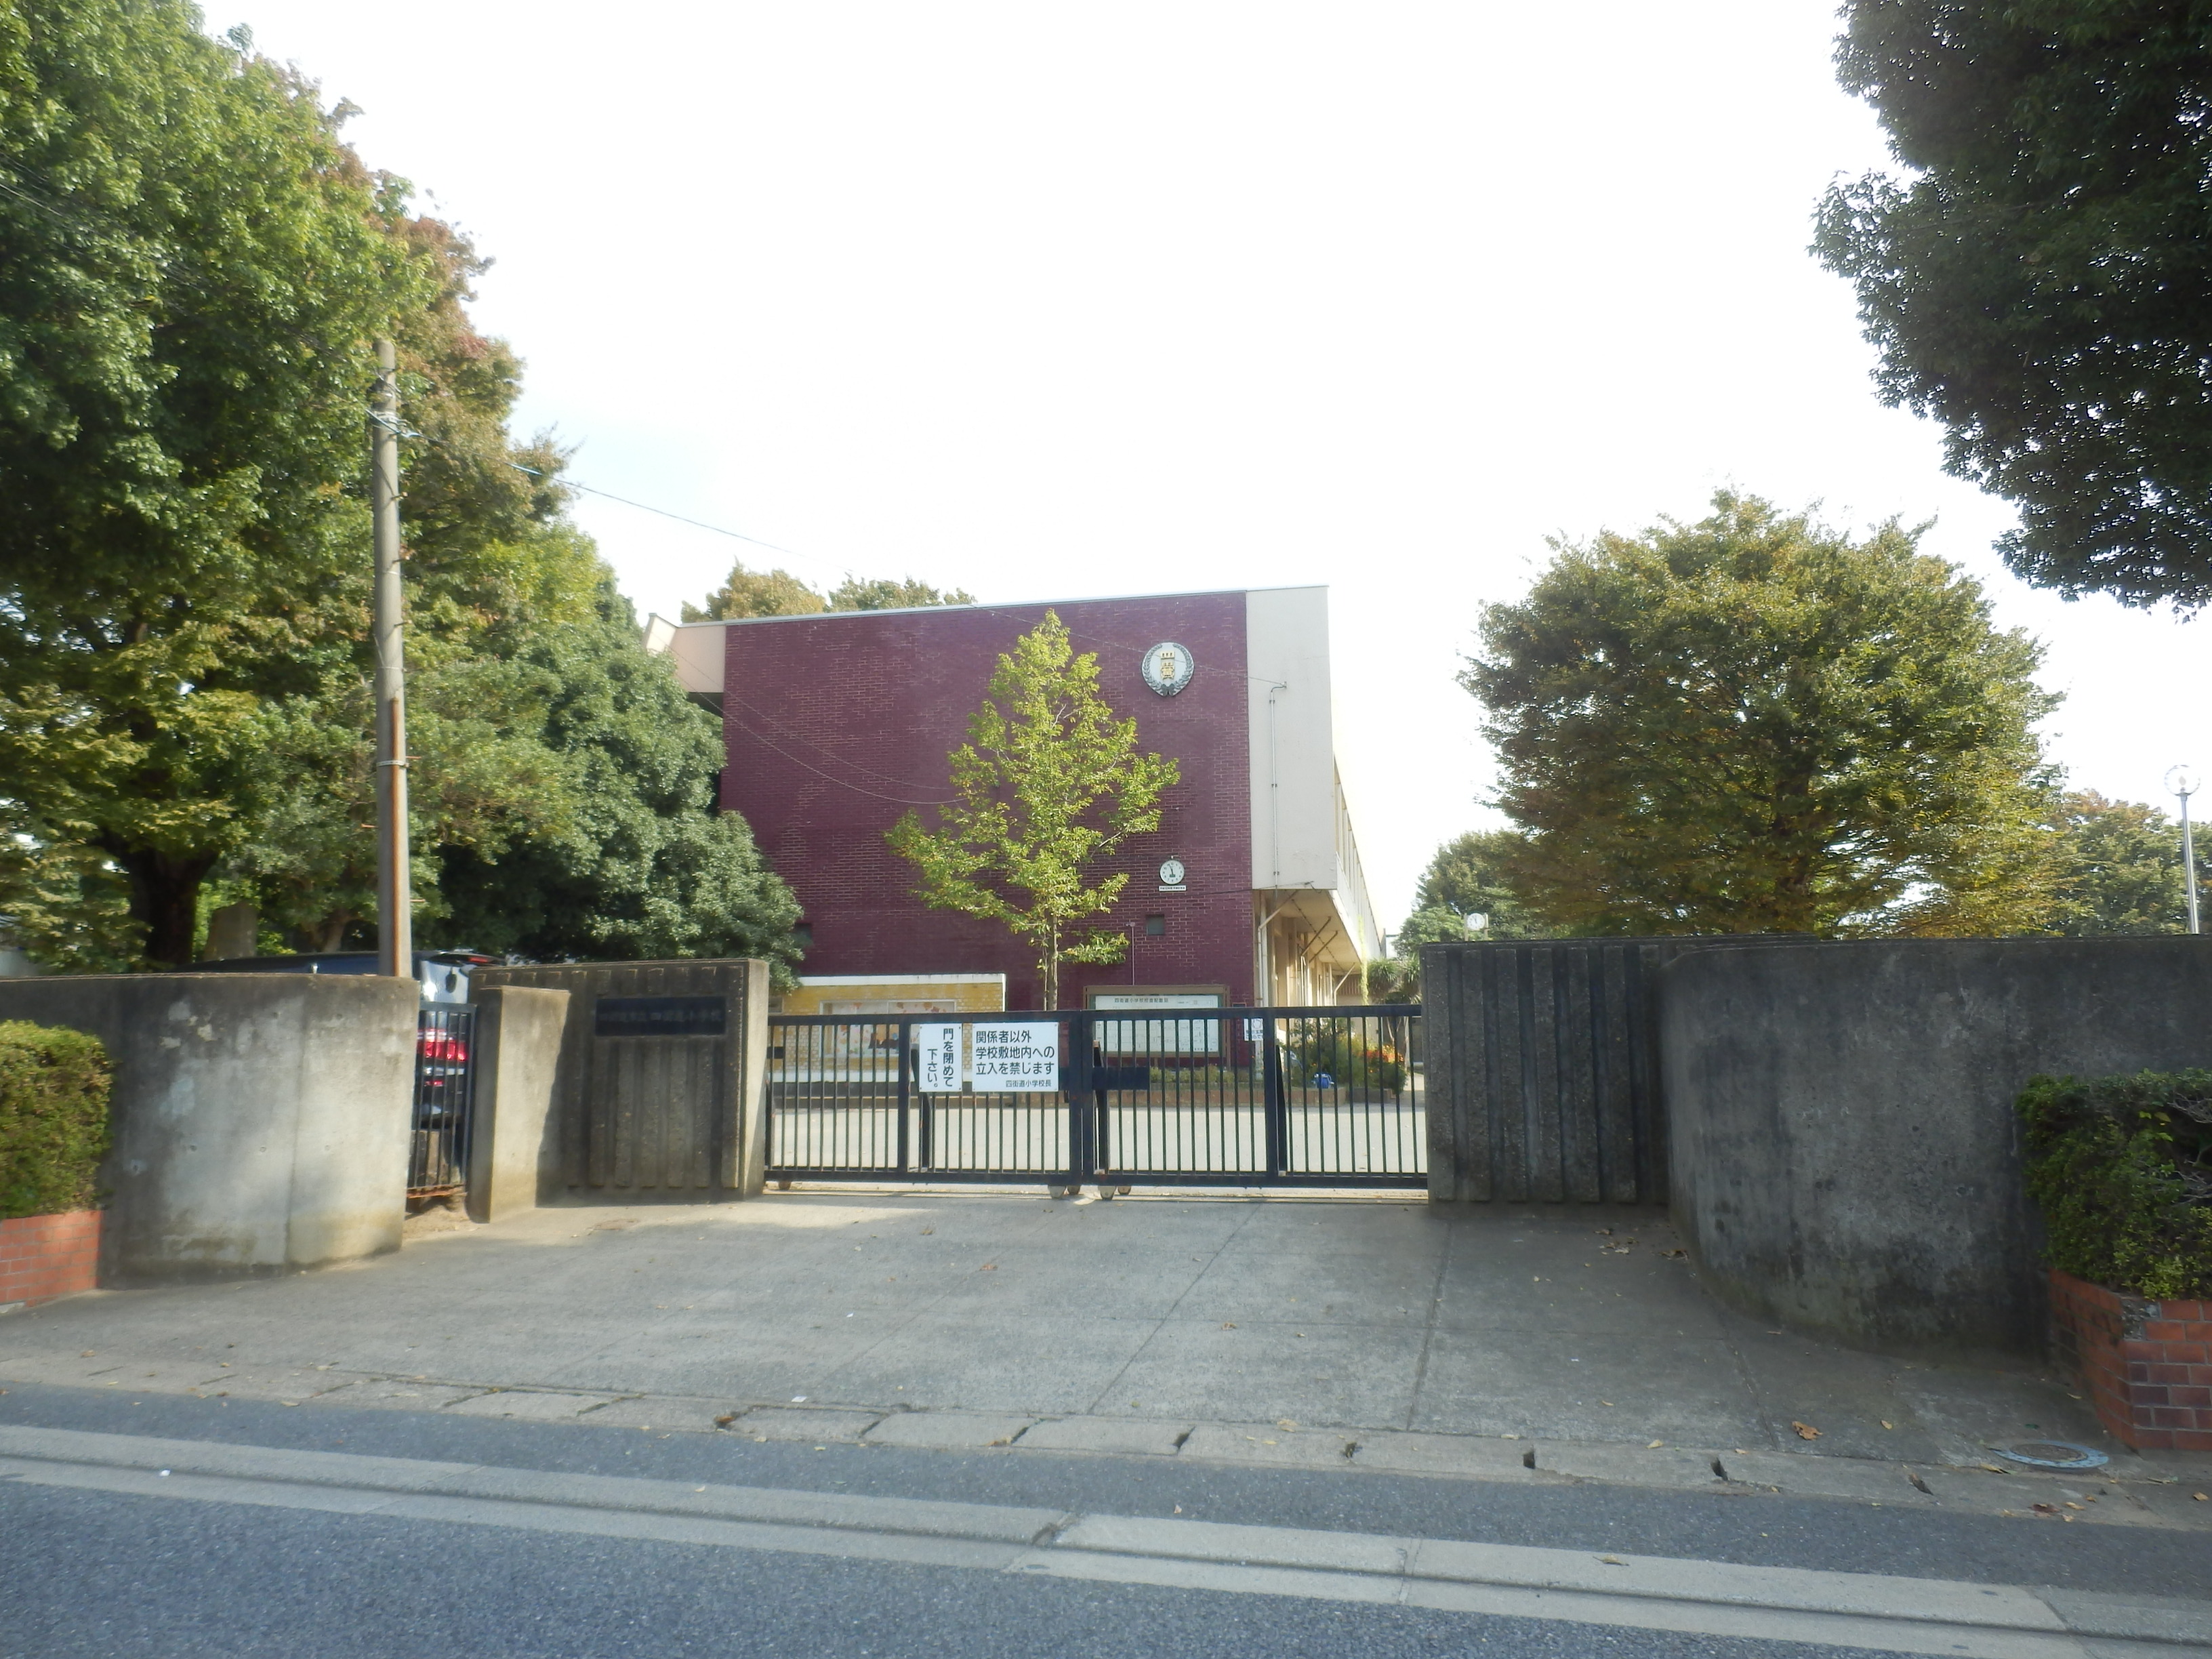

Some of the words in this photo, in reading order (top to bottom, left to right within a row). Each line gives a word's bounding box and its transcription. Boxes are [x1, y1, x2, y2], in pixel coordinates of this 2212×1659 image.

[976, 1030, 1031, 1043] 関係者以外
[943, 1028, 954, 1087] 門を閉めて
[976, 1046, 1054, 1059] 学校敷地内への
[927, 1048, 938, 1088] 下さい。
[976, 1062, 1054, 1076] 立入を禁じます
[1006, 1080, 1052, 1088] 四街道小学校長
